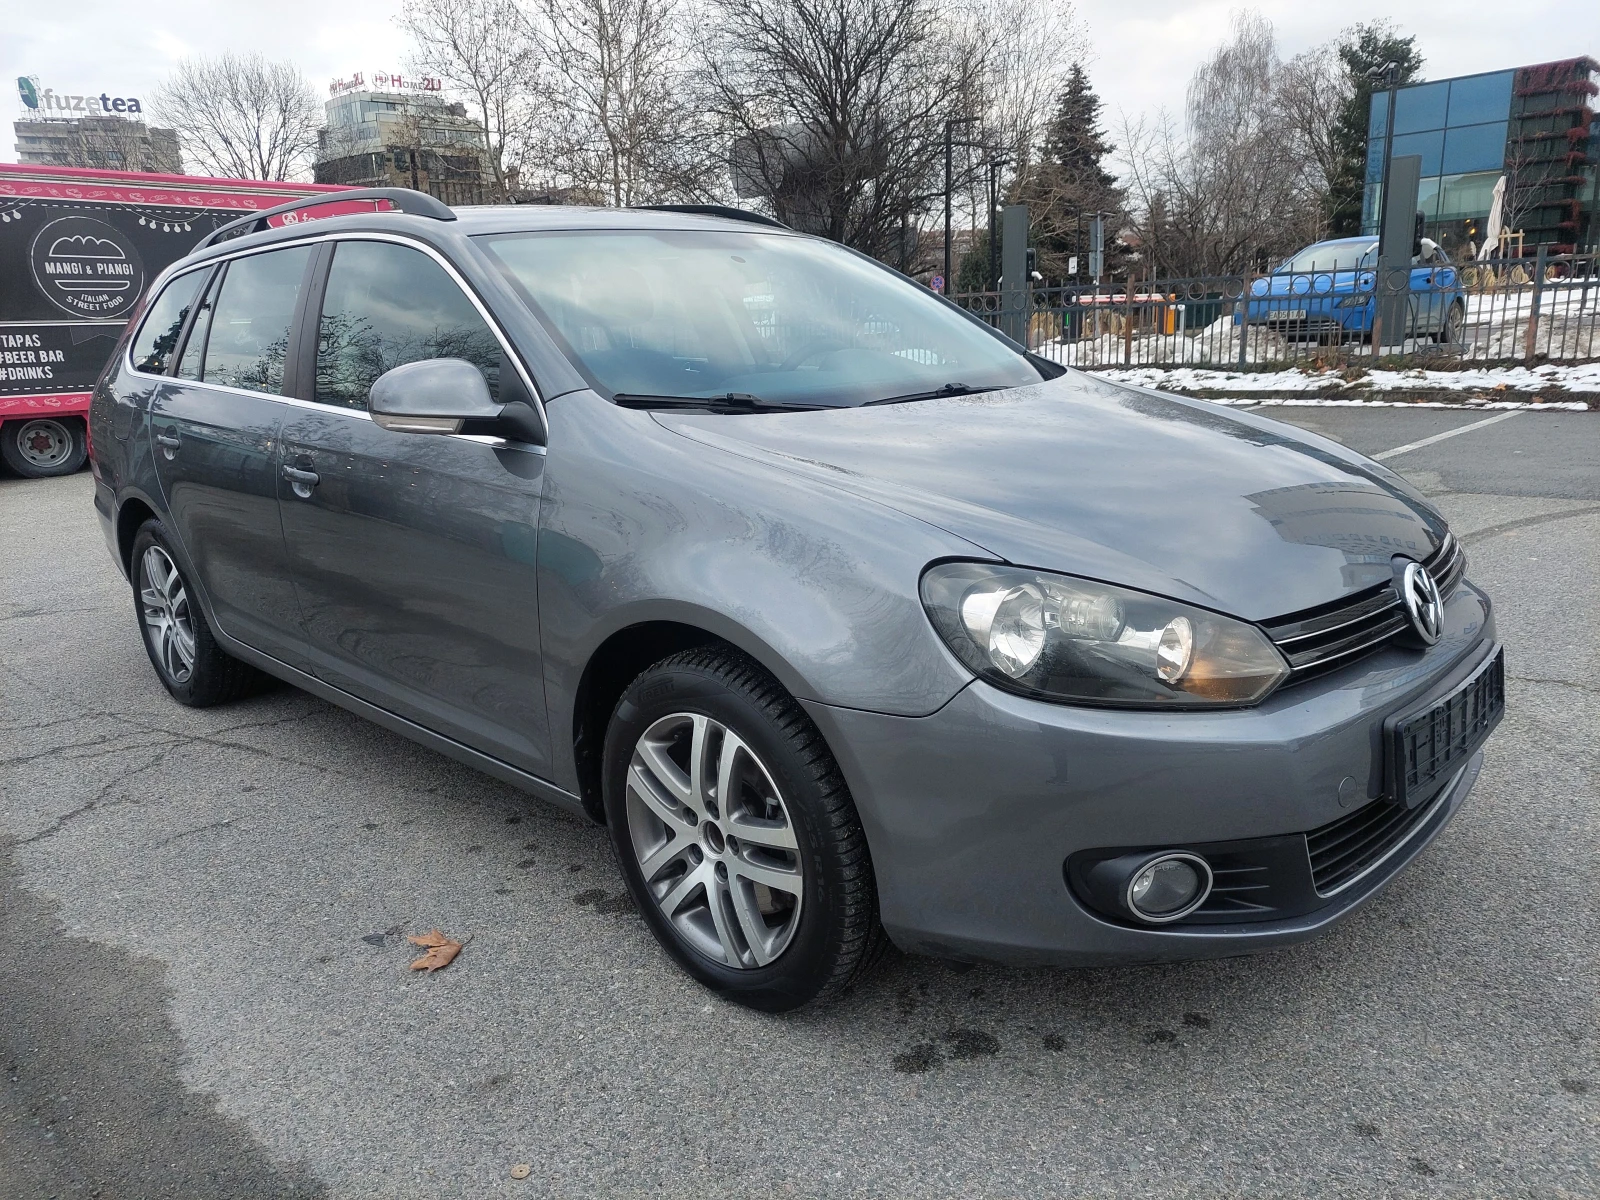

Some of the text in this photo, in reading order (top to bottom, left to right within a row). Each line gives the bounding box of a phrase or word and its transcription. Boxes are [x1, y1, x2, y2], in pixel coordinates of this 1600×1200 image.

[42, 88, 142, 112] fuzetea
[45, 262, 134, 275] MANGI & PIANGI
[66, 295, 125, 311] STREET FOOD
[81, 293, 109, 303] ITALIAN
[39, 350, 65, 363] BAR
[0, 366, 53, 381] #DRINKS
